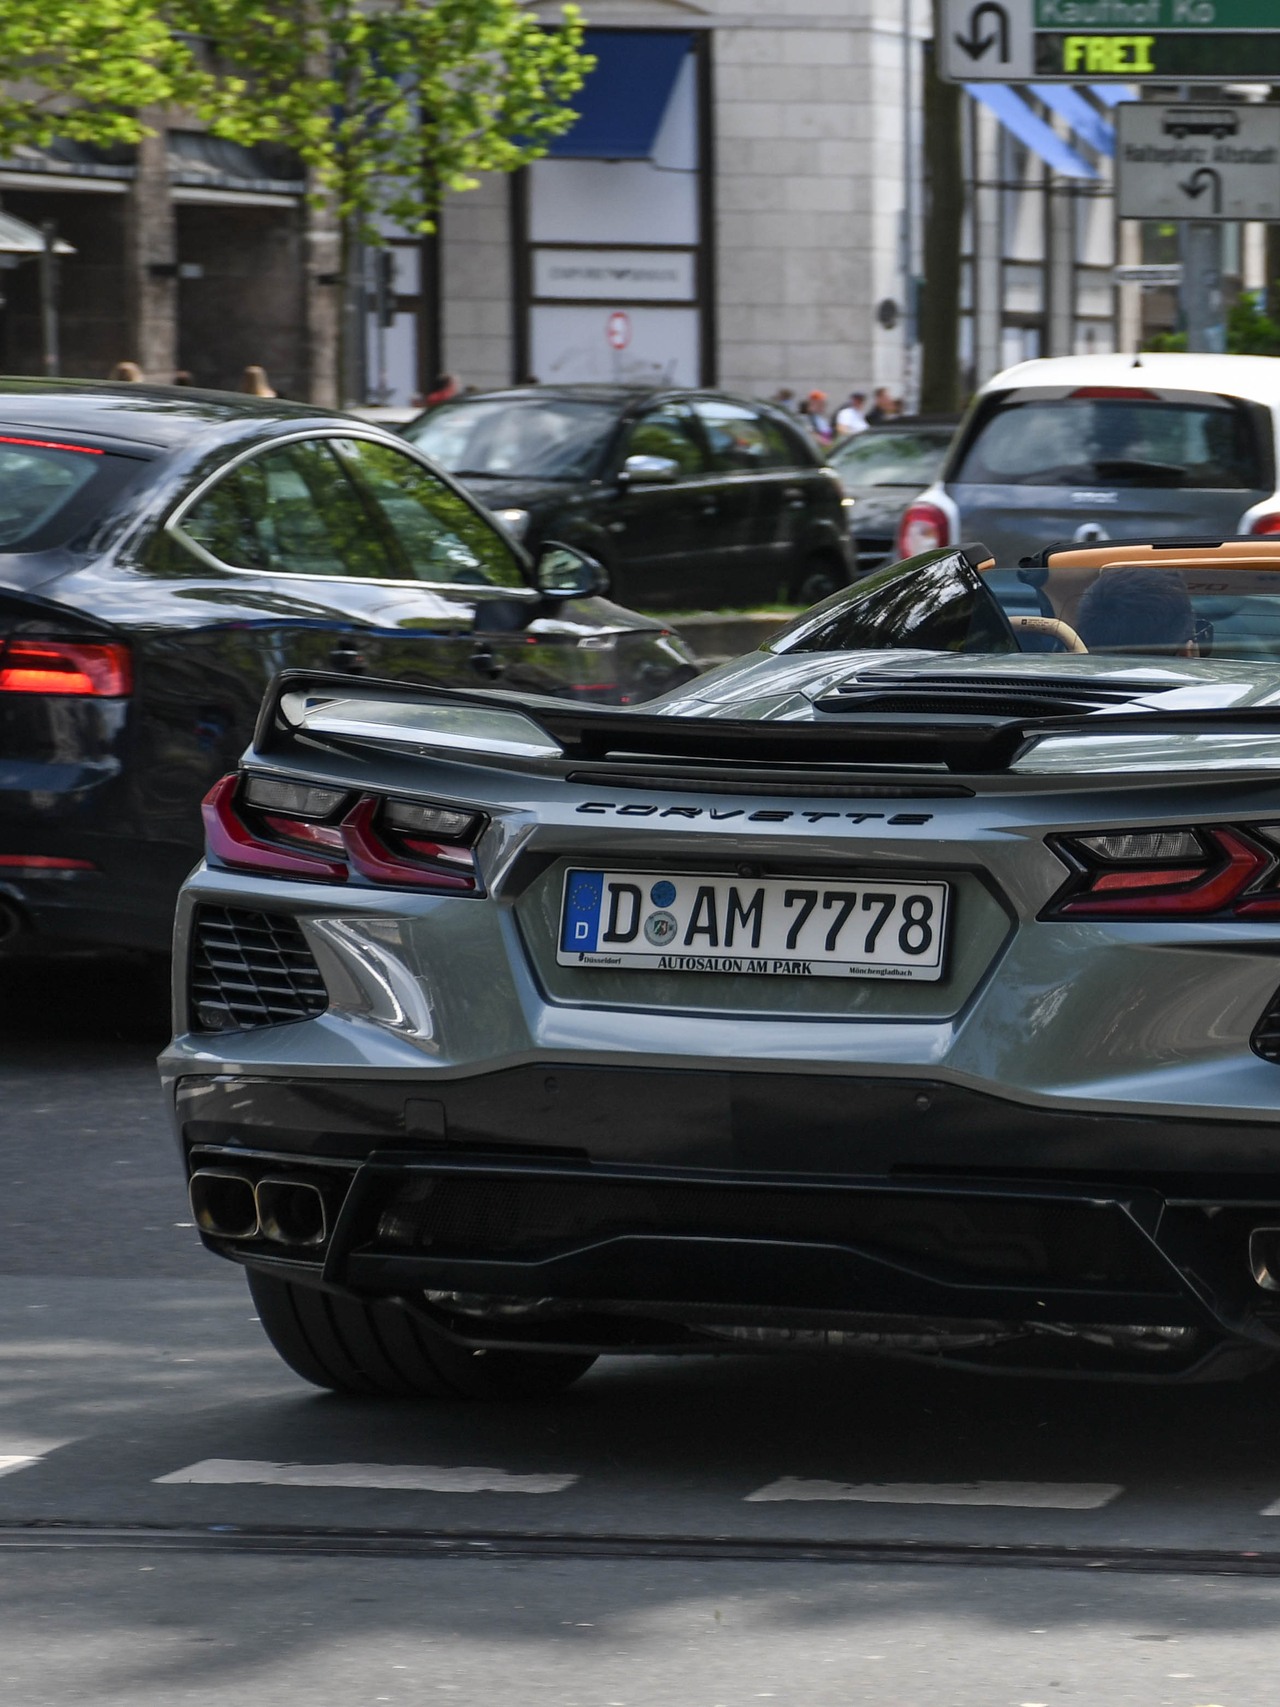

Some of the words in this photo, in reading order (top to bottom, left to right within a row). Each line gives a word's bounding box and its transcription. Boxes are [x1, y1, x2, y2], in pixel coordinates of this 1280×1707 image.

[1038, 0, 1160, 23] Kaufhof
[1064, 36, 1155, 72] FREI
[576, 802, 934, 825] CORVETTE
[603, 883, 642, 942] D
[684, 886, 765, 948] AM
[784, 889, 933, 955] 7778
[575, 922, 589, 939] D
[584, 956, 622, 965] Düsseldorf
[658, 956, 742, 972] AUTOSALON
[747, 959, 768, 973] AM
[773, 961, 812, 975] PARK
[849, 966, 913, 977] Mönchengladbach
